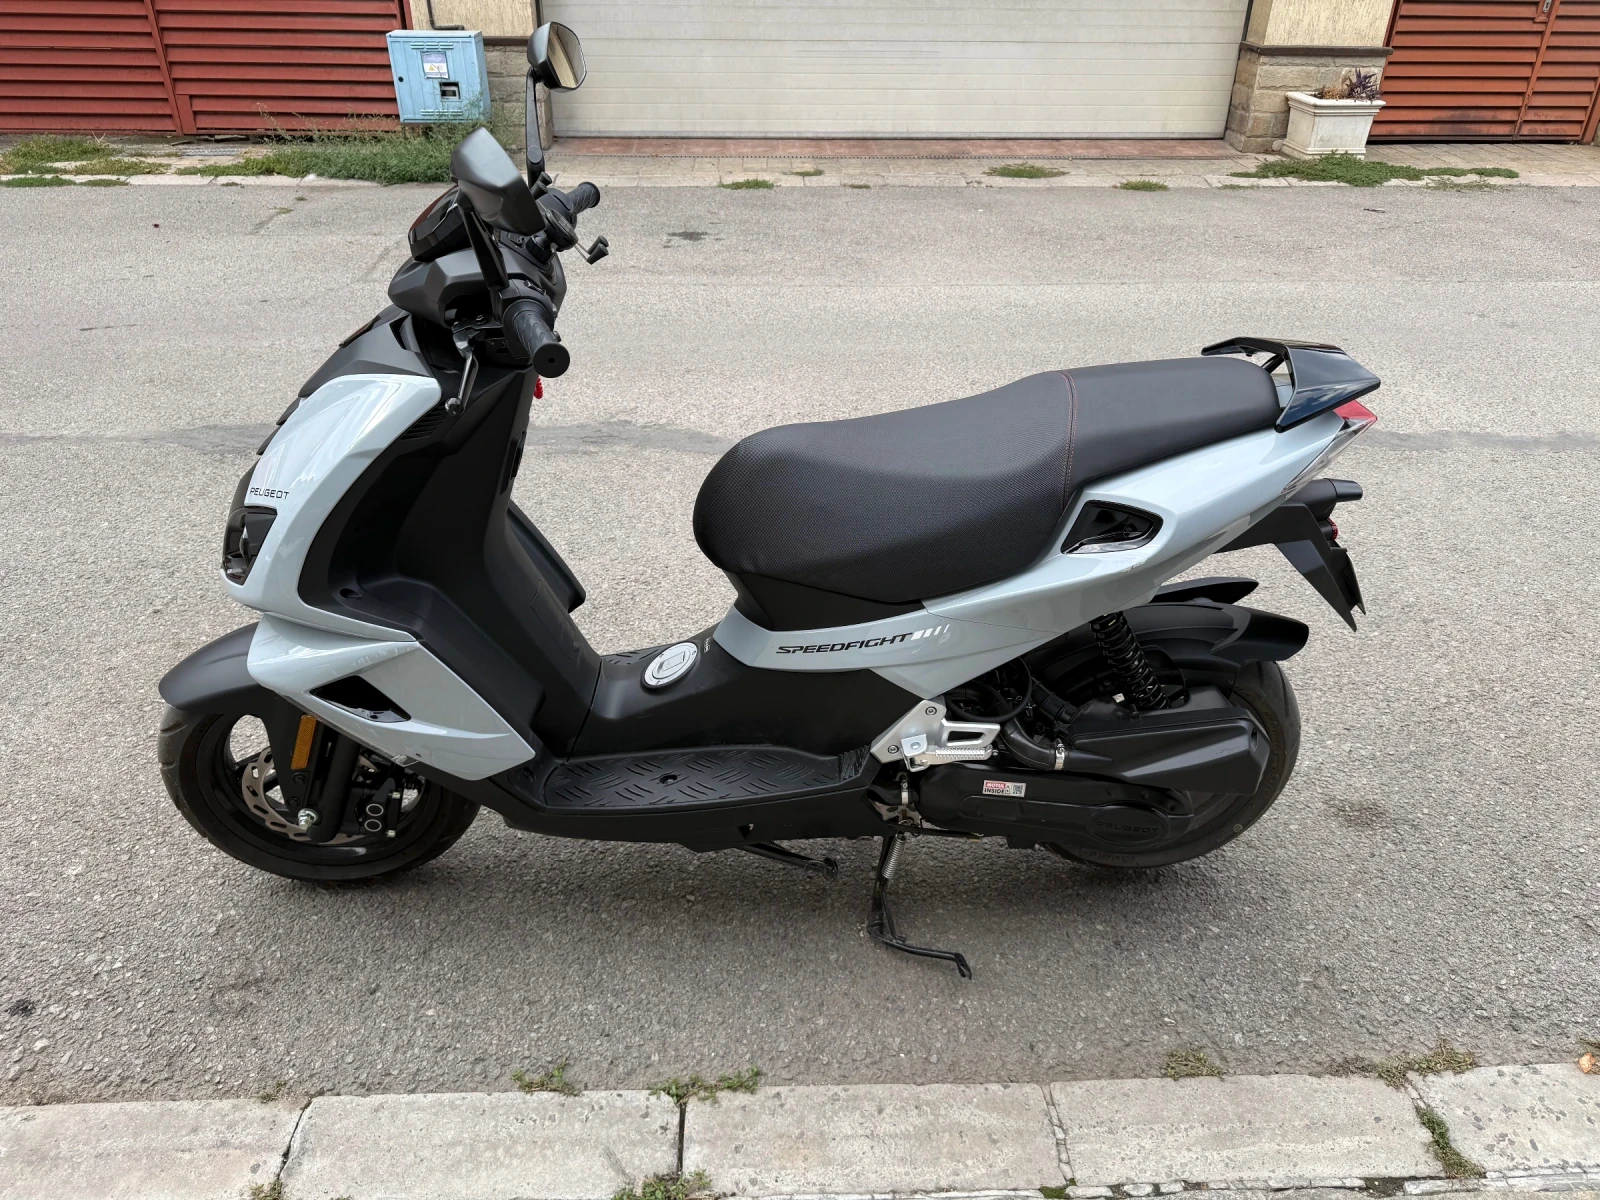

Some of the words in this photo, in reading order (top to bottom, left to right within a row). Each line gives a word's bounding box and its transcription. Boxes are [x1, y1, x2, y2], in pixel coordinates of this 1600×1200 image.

[250, 487, 289, 499] PEUGEOT
[776, 632, 913, 654] SPEEDFIGHT
[1096, 821, 1160, 833] PEUGEOT
